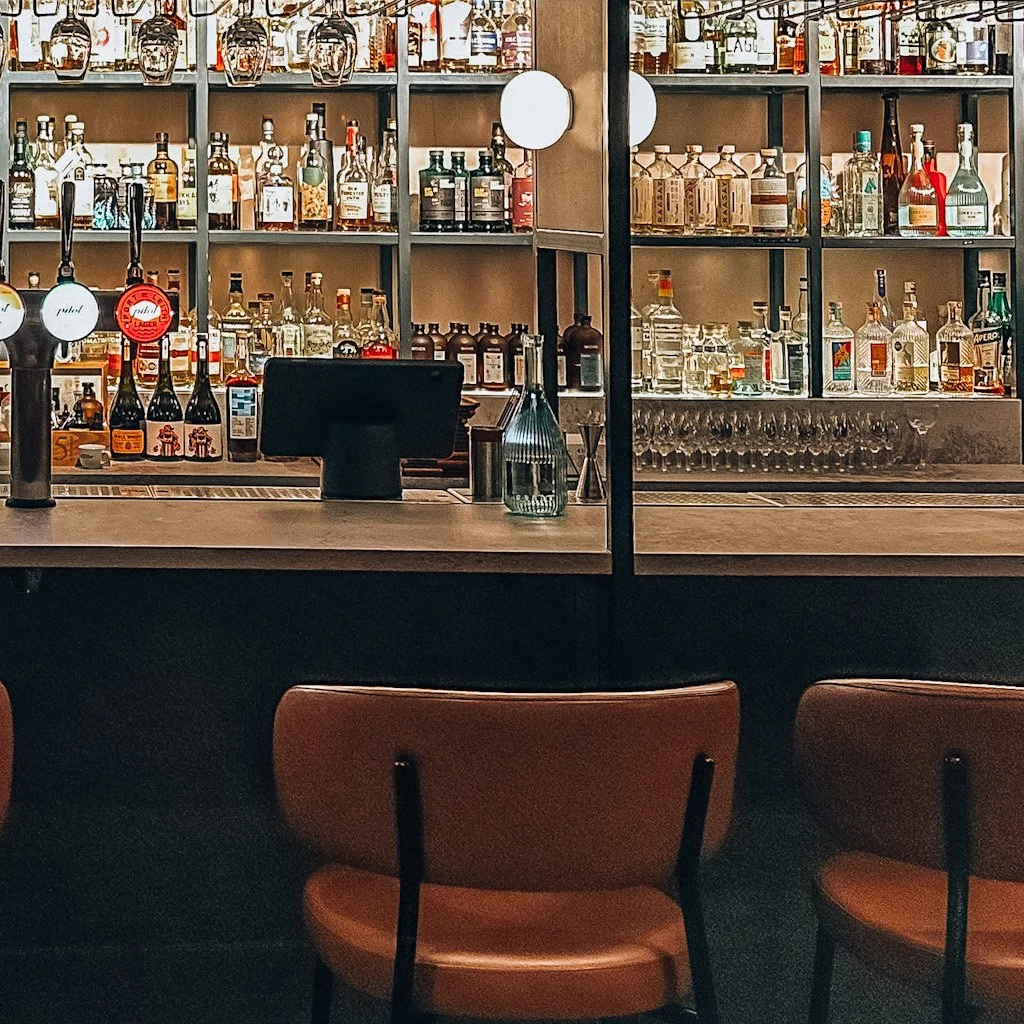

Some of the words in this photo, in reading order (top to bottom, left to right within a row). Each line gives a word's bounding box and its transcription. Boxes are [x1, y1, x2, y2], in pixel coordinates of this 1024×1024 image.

[657, 181, 665, 223] RAASAY
[687, 180, 696, 223] RAASAY
[56, 304, 84, 317] pilot
[123, 293, 137, 320] PORT
[151, 293, 168, 320] LEITH
[133, 305, 159, 317] pilot
[974, 332, 1001, 343] APERO
